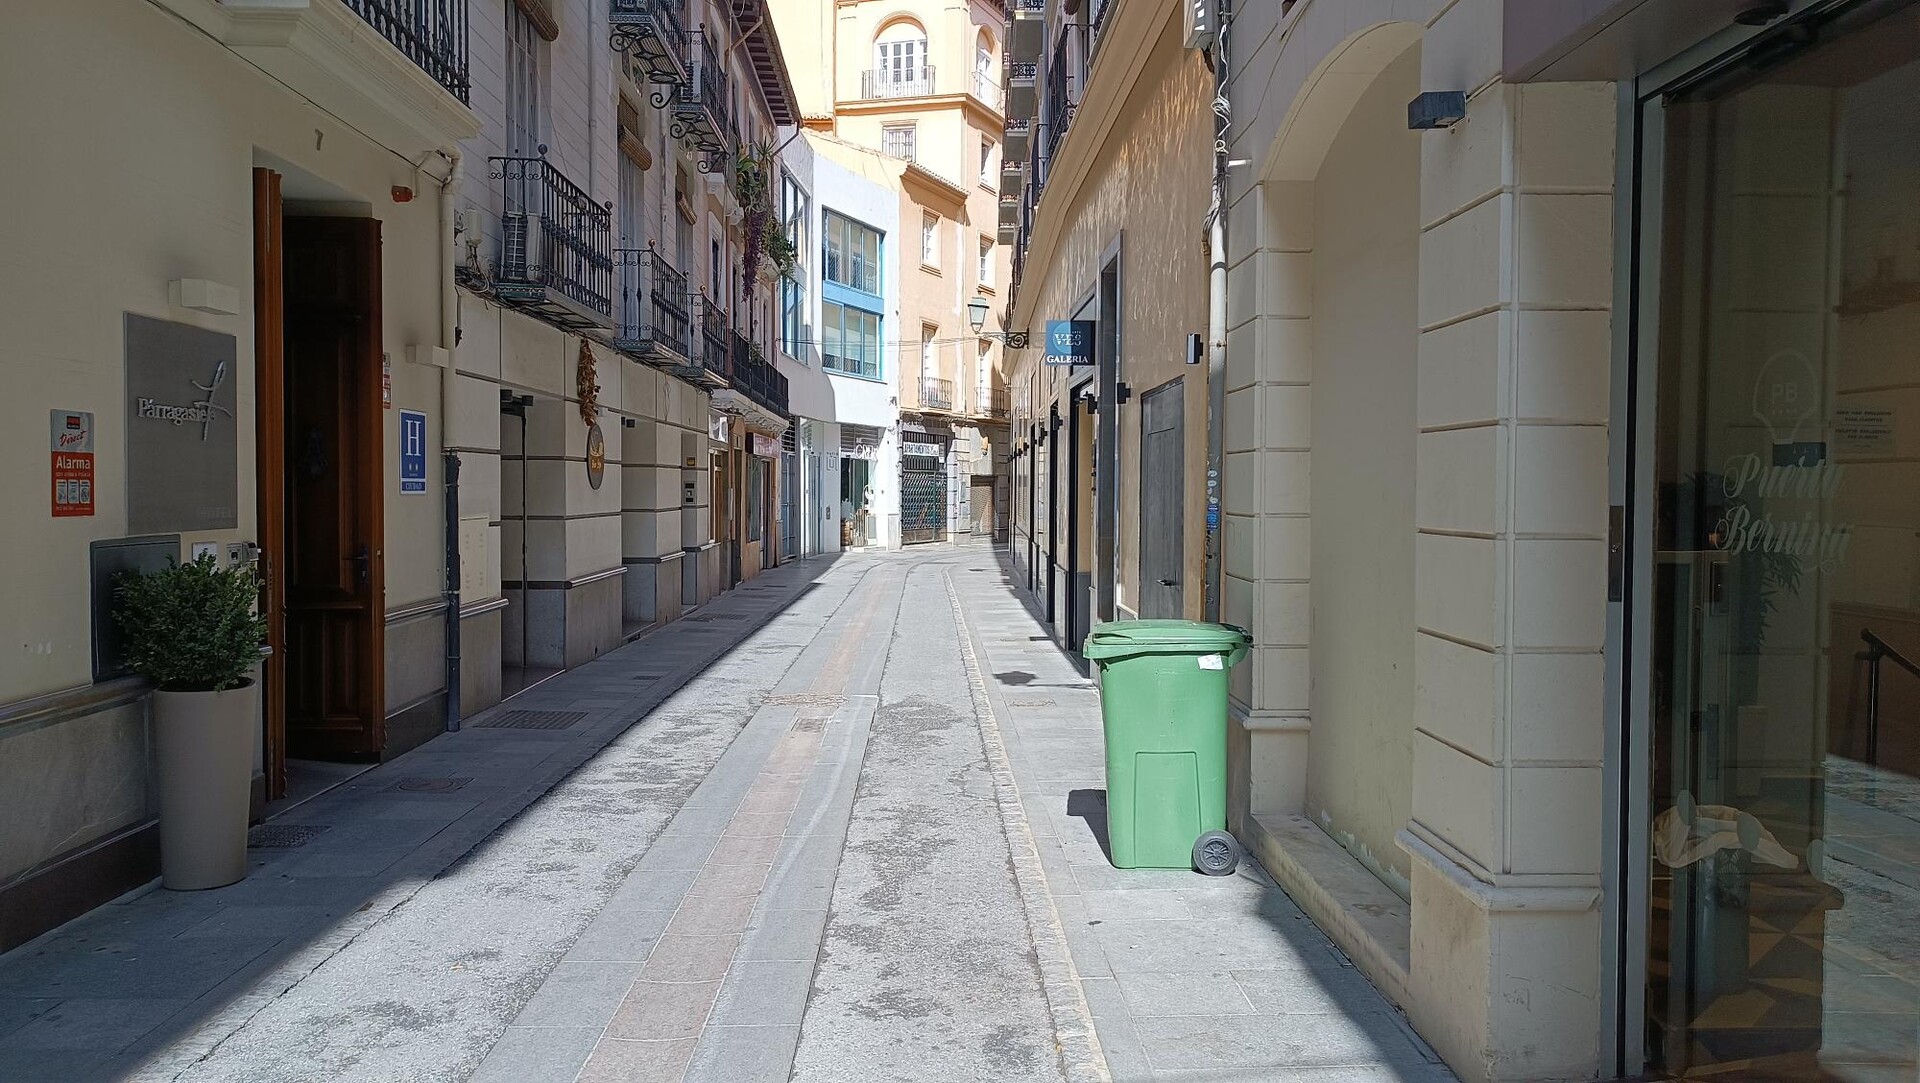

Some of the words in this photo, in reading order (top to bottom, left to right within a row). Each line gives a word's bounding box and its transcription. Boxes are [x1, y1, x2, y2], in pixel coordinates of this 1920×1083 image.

[314, 128, 324, 151] 7
[1046, 355, 1089, 364] GALERIA
[1771, 382, 1798, 404] PB
[405, 419, 422, 457] H
[56, 455, 91, 470] Alarma
